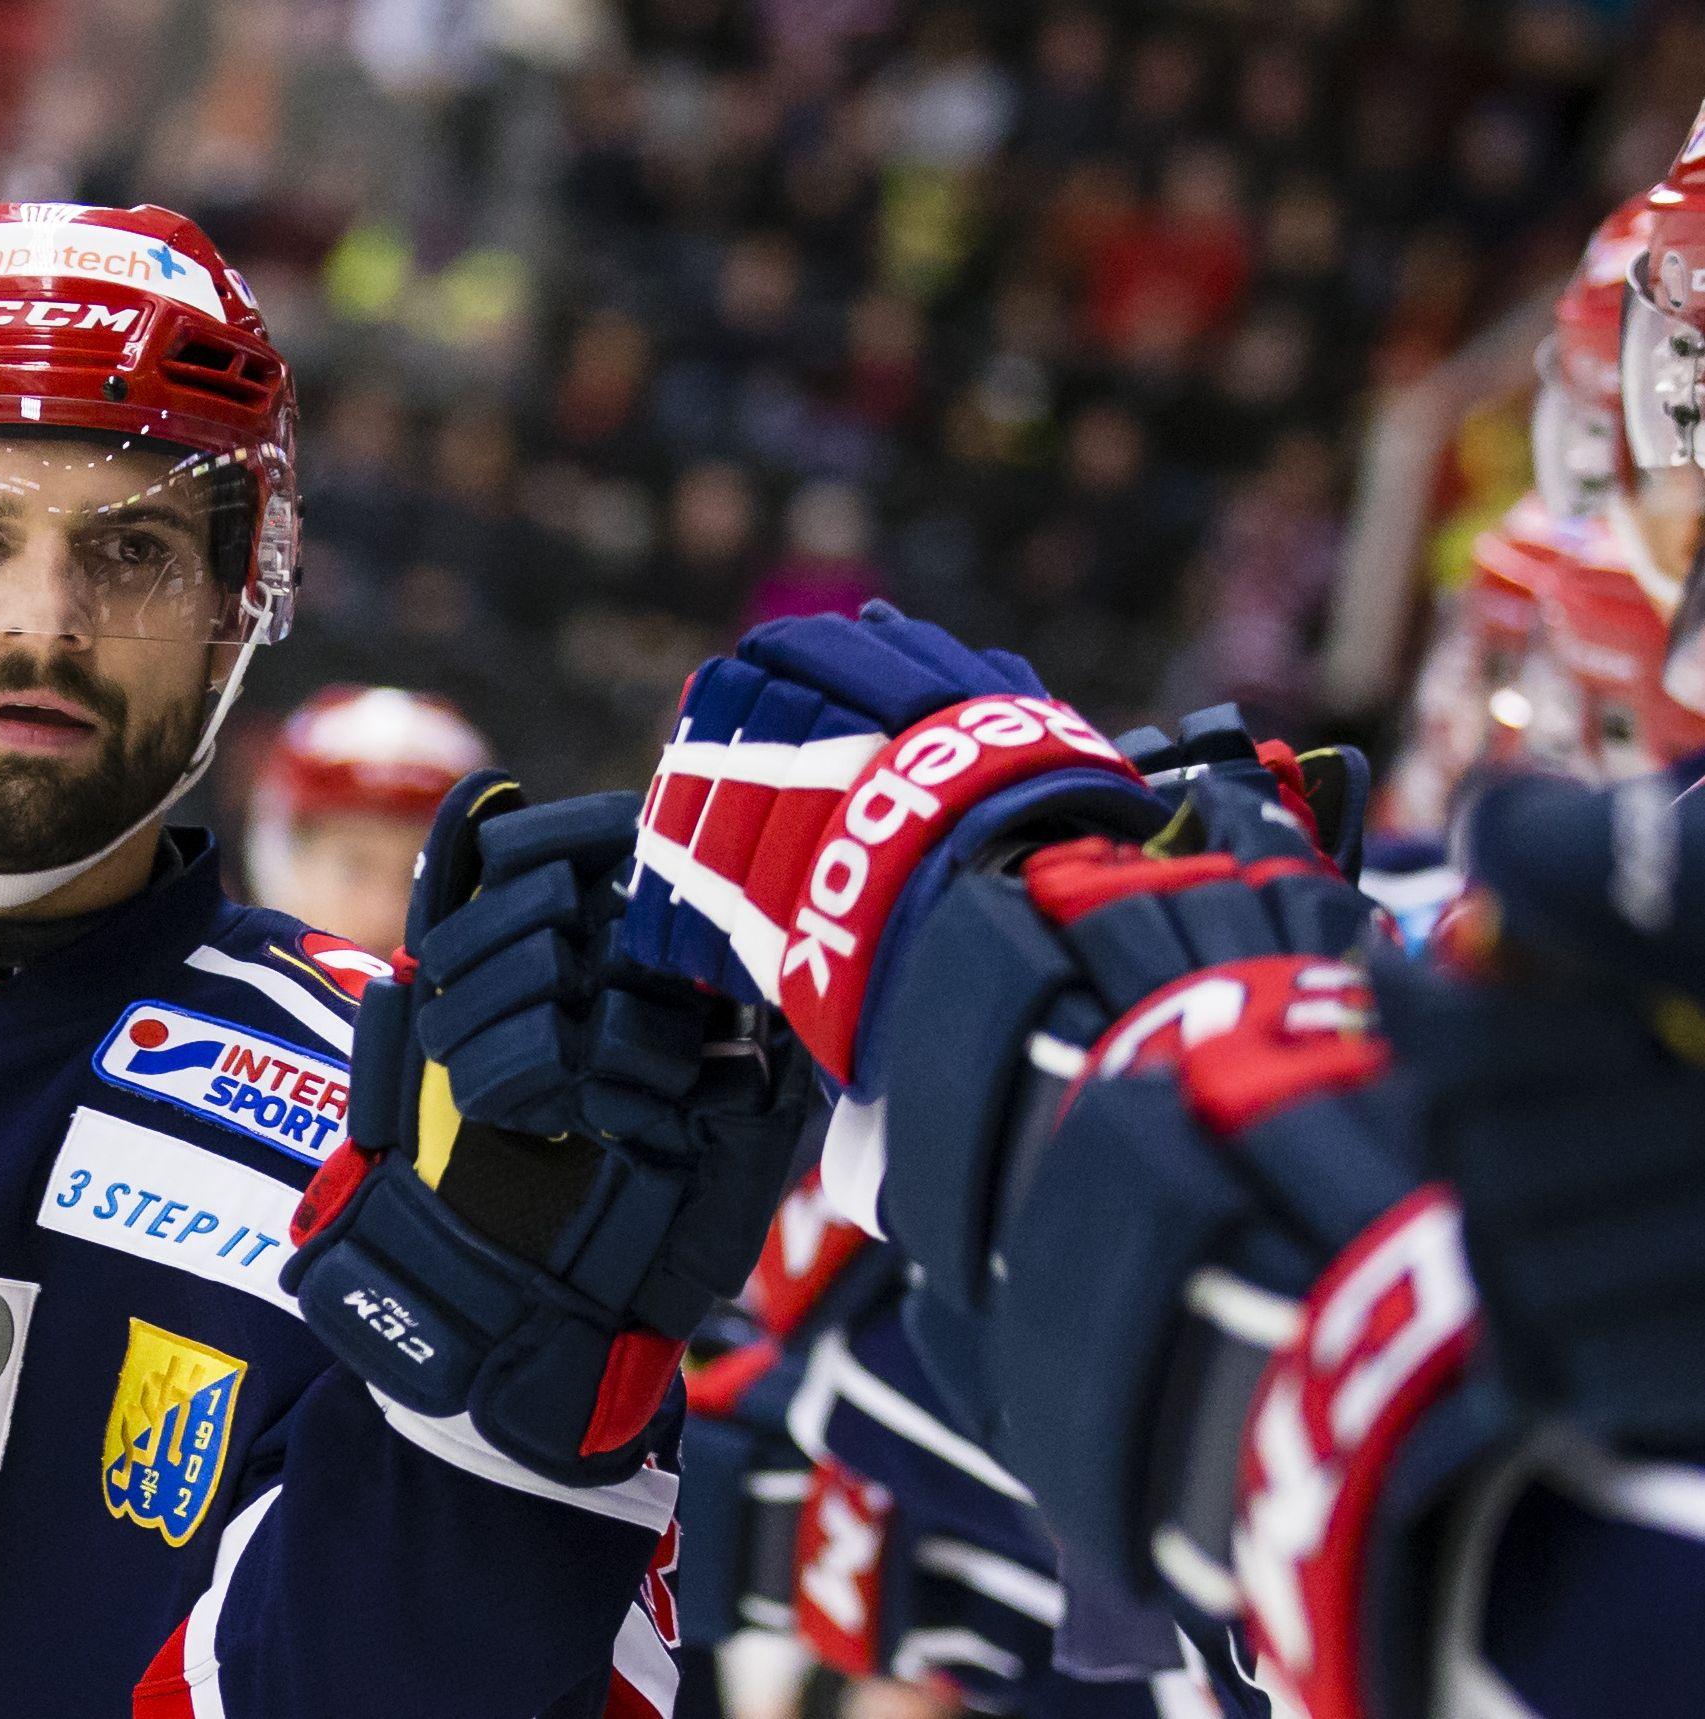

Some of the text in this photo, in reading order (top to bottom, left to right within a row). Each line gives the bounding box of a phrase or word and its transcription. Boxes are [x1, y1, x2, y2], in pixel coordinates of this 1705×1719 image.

[782, 697, 1123, 998] Reebok
[203, 1077, 340, 1152] SPORT
[220, 1044, 350, 1119] INTER
[56, 1168, 281, 1268] 3 STEP IT
[342, 1289, 434, 1365] CCM
